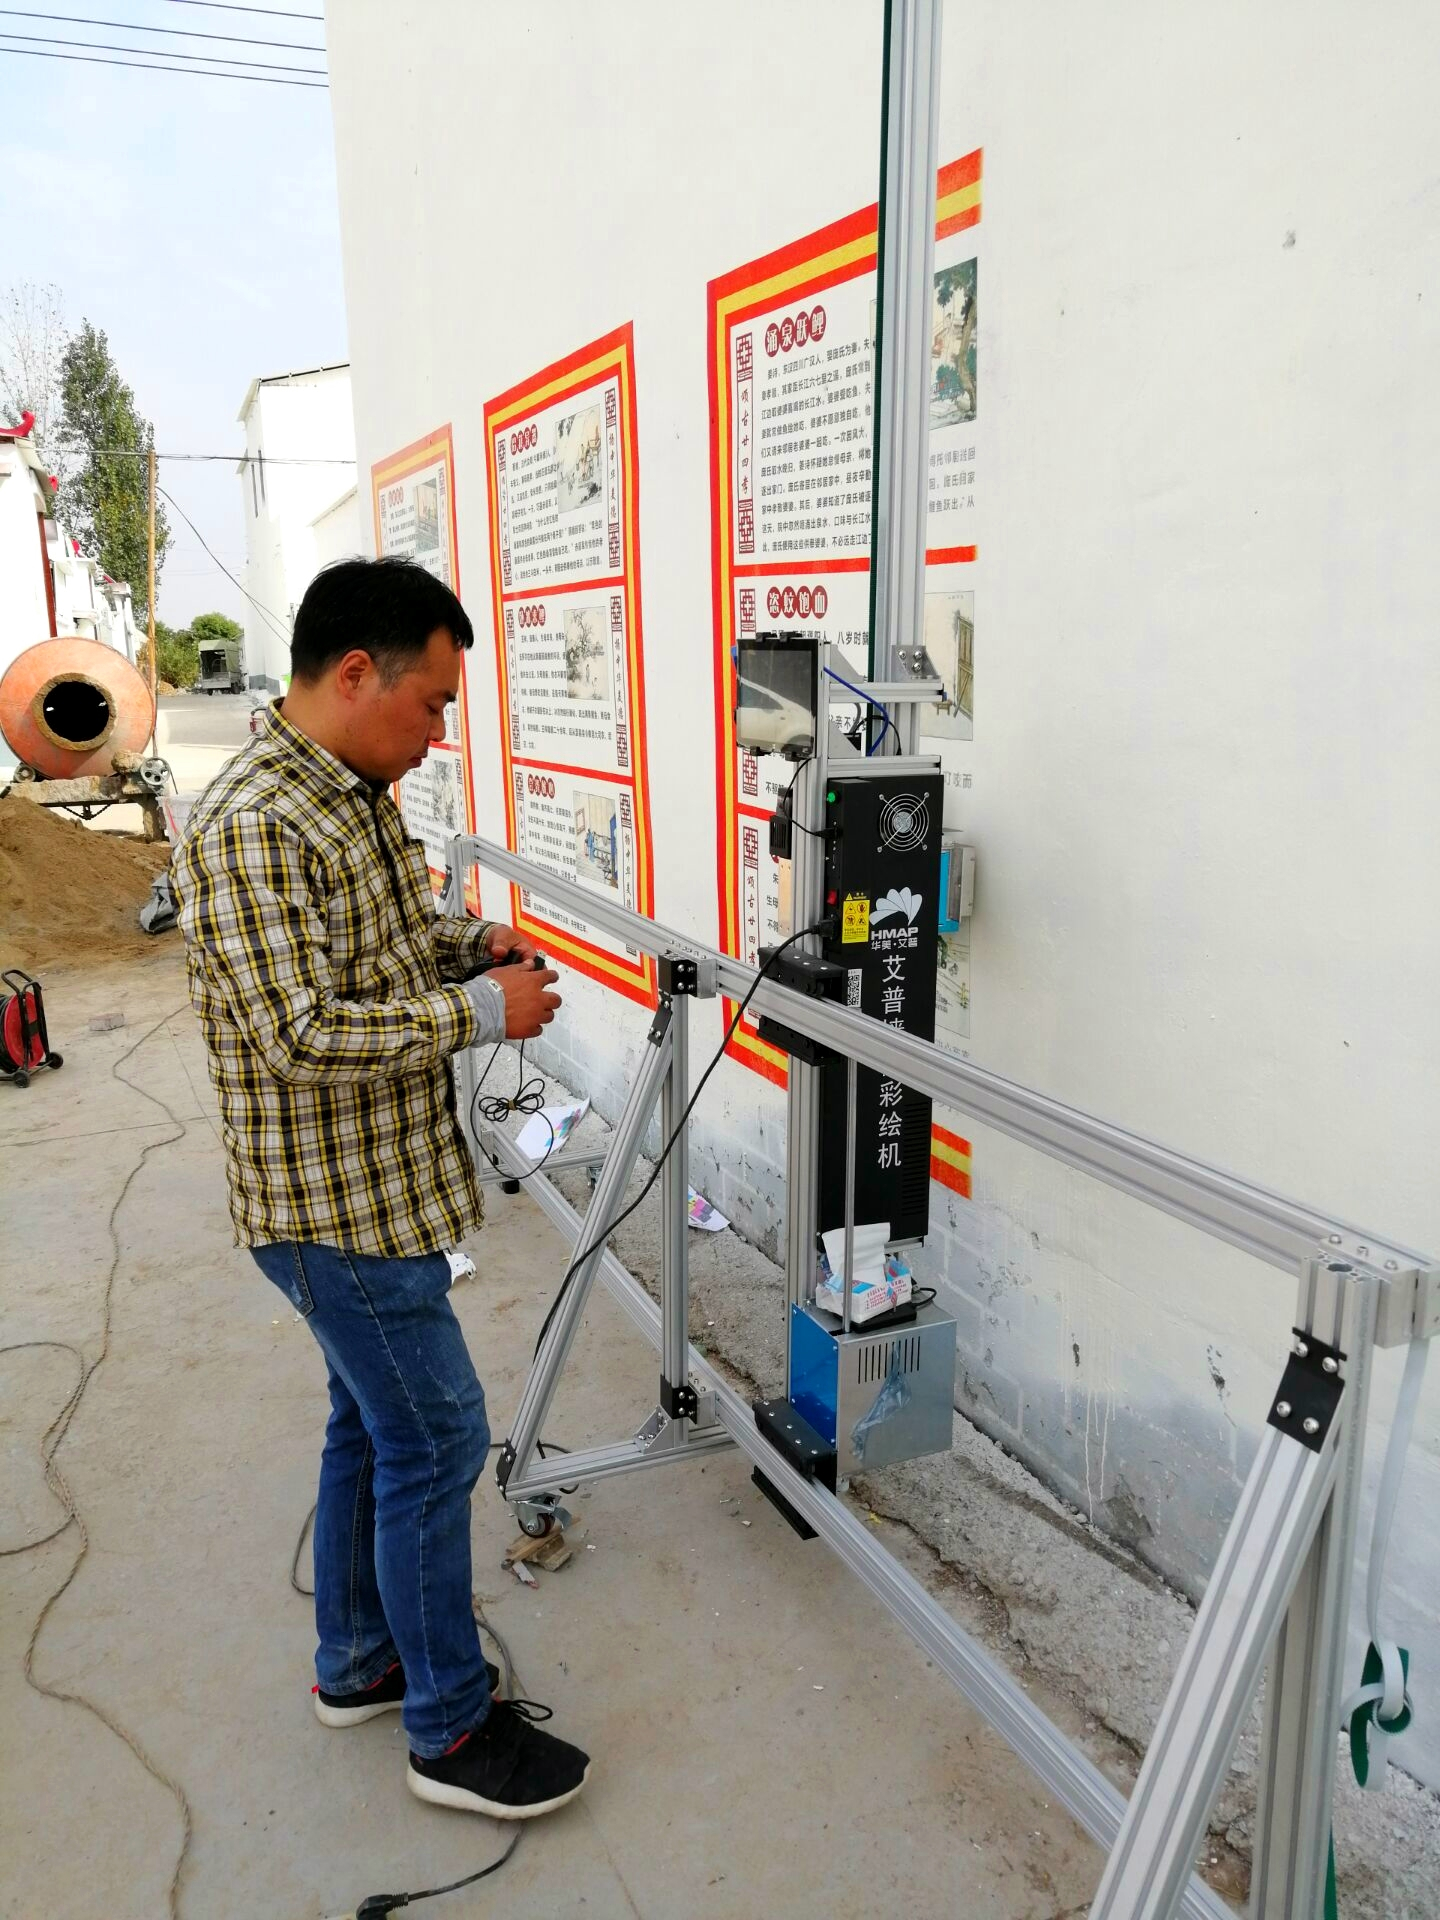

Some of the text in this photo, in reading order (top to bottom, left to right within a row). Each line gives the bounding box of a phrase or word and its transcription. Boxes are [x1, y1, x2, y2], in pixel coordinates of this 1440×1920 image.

[766, 310, 825, 354] 涌泉跃鲤
[871, 927, 919, 941] HMAP
